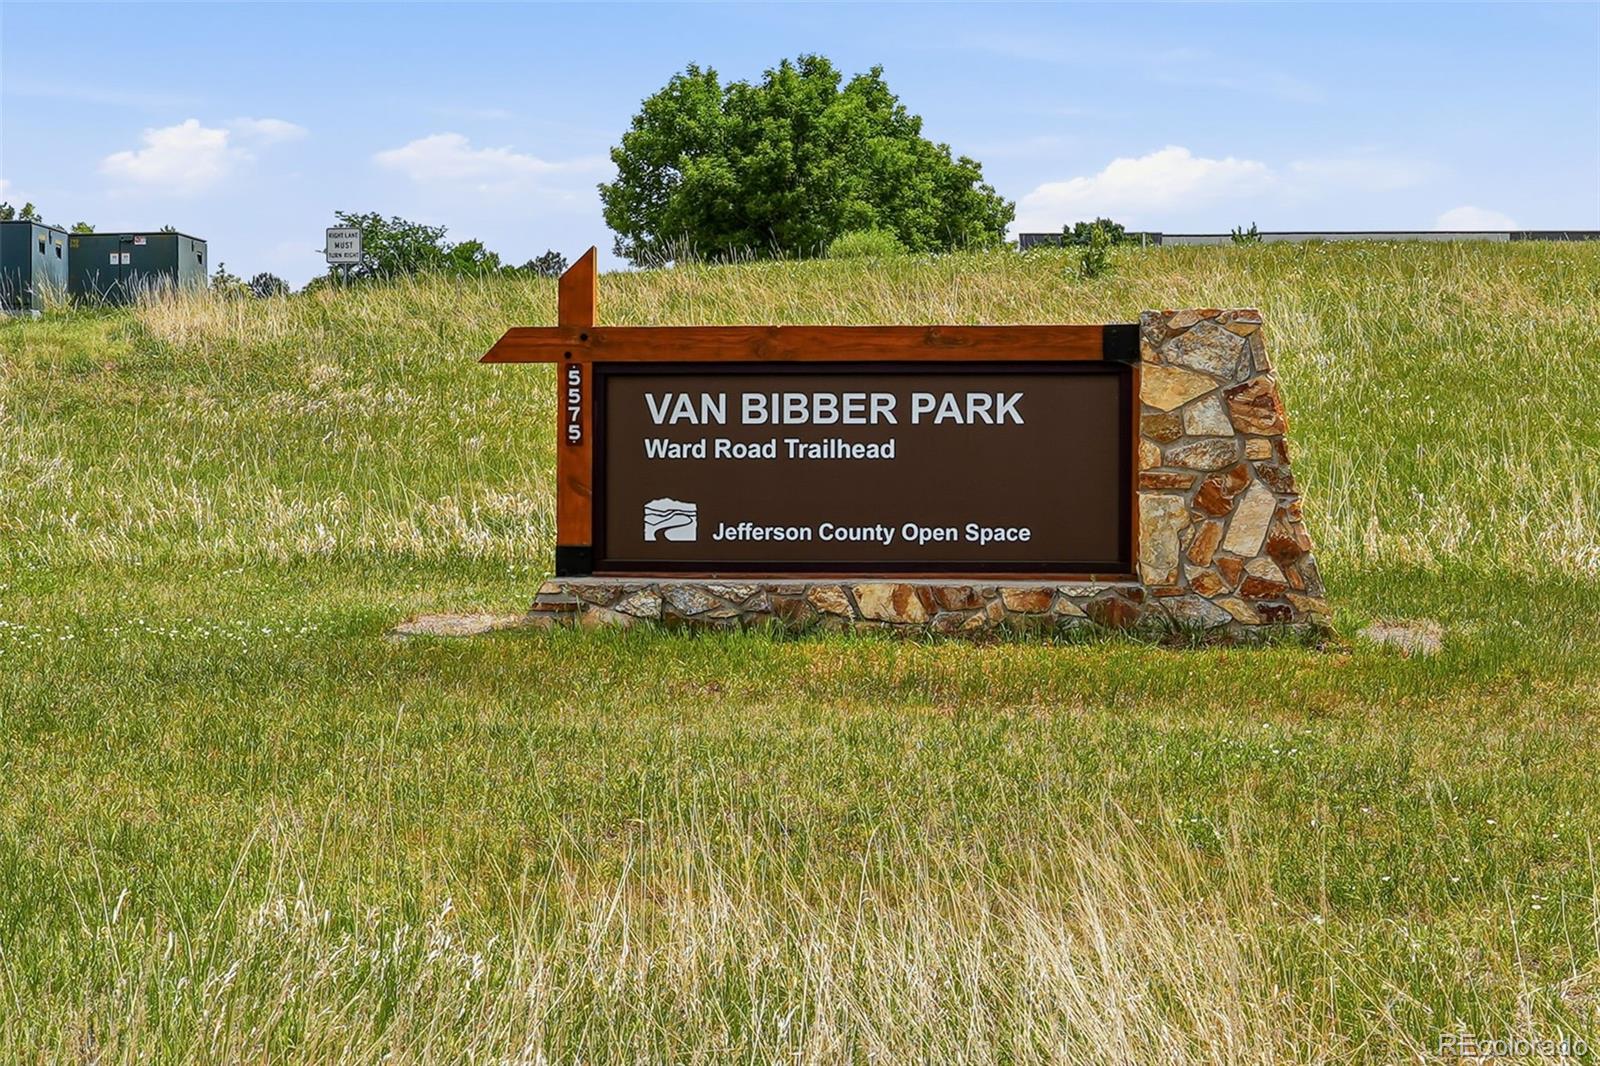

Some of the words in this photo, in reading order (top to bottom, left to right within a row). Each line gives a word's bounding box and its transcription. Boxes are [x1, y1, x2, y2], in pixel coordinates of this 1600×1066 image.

[334, 241, 353, 249] MUST
[568, 370, 581, 440] 5575
[644, 392, 726, 425] VAN
[742, 392, 898, 425] BIBBER
[912, 392, 1025, 425] PARK
[644, 438, 706, 459] Ward
[715, 438, 777, 459] Road
[784, 438, 895, 459] Trailhead
[712, 522, 812, 541] Jefferson
[819, 522, 895, 546] County
[902, 523, 958, 546] Open
[966, 523, 1031, 546] Space
